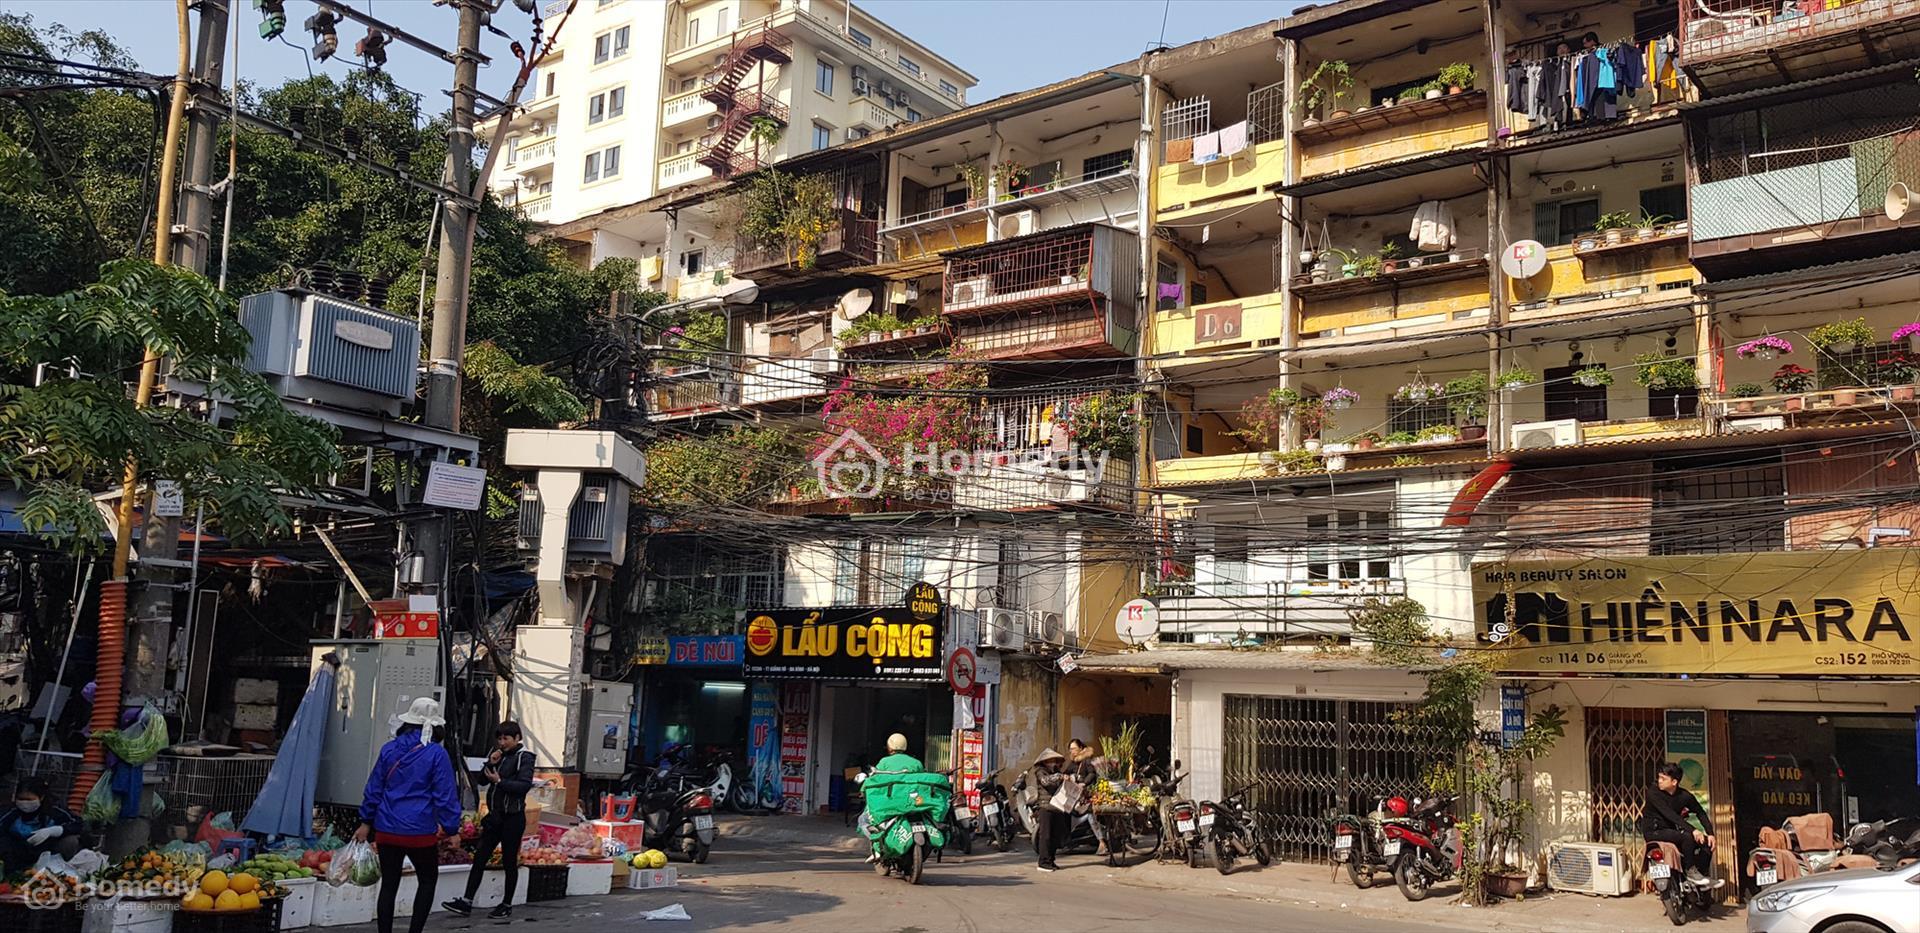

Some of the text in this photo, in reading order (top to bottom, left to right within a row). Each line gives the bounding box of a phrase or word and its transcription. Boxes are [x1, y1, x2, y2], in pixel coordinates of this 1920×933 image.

[1521, 569, 1573, 582] BEAUTY
[1579, 567, 1627, 581] SALON
[916, 584, 934, 600] LẨU
[911, 600, 938, 614] CỘNG
[782, 611, 934, 664] LẨU CỘNG
[1558, 653, 1579, 664] 114
[1586, 652, 1606, 664] D6
[1839, 653, 1867, 665] 152
